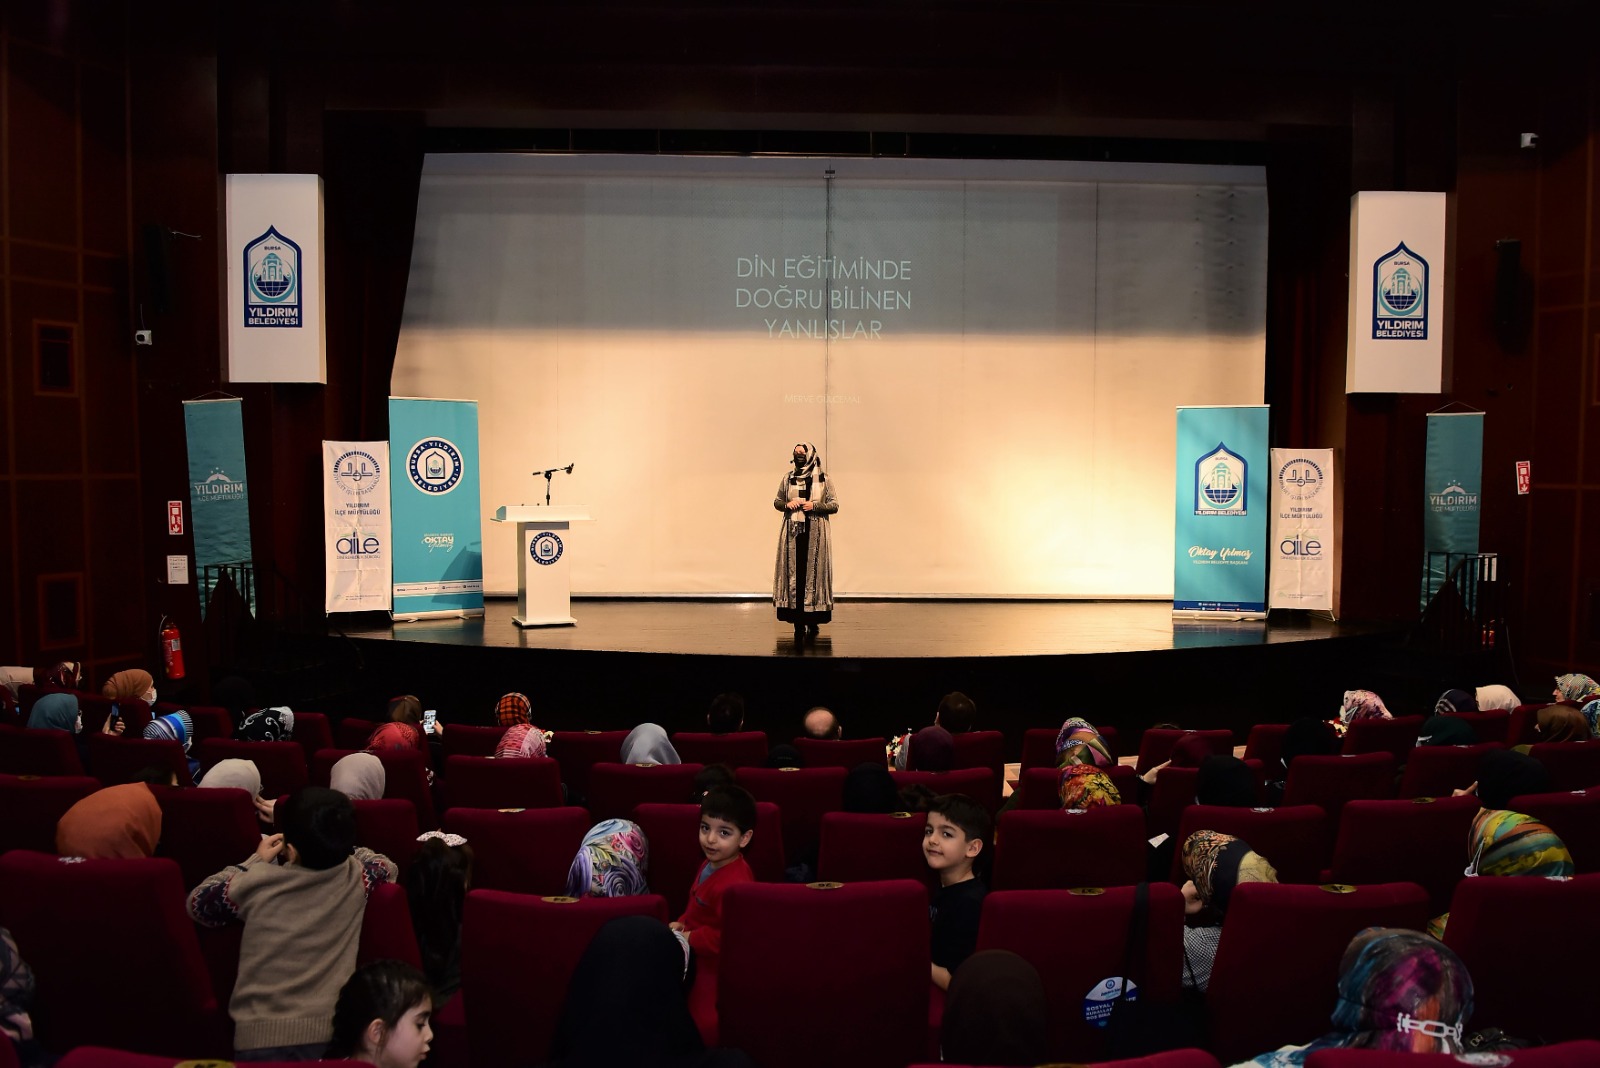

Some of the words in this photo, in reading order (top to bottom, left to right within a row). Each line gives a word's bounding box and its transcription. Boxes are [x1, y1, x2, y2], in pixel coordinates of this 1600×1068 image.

[737, 254, 775, 278] DİN
[784, 254, 912, 280] EĞİTİMİNDE
[736, 284, 823, 309] DOĞRU
[831, 285, 911, 310] BİLİNEN
[248, 307, 298, 317] YILDIRIM
[764, 318, 883, 343] YANLIŞLAR
[1377, 320, 1424, 330] YILDIRIM
[194, 483, 244, 495] YILDIRIM
[1429, 495, 1477, 505] YILDIRIM
[1188, 545, 1218, 560] Oktay
[1086, 1002, 1111, 1012] SOSYAL
